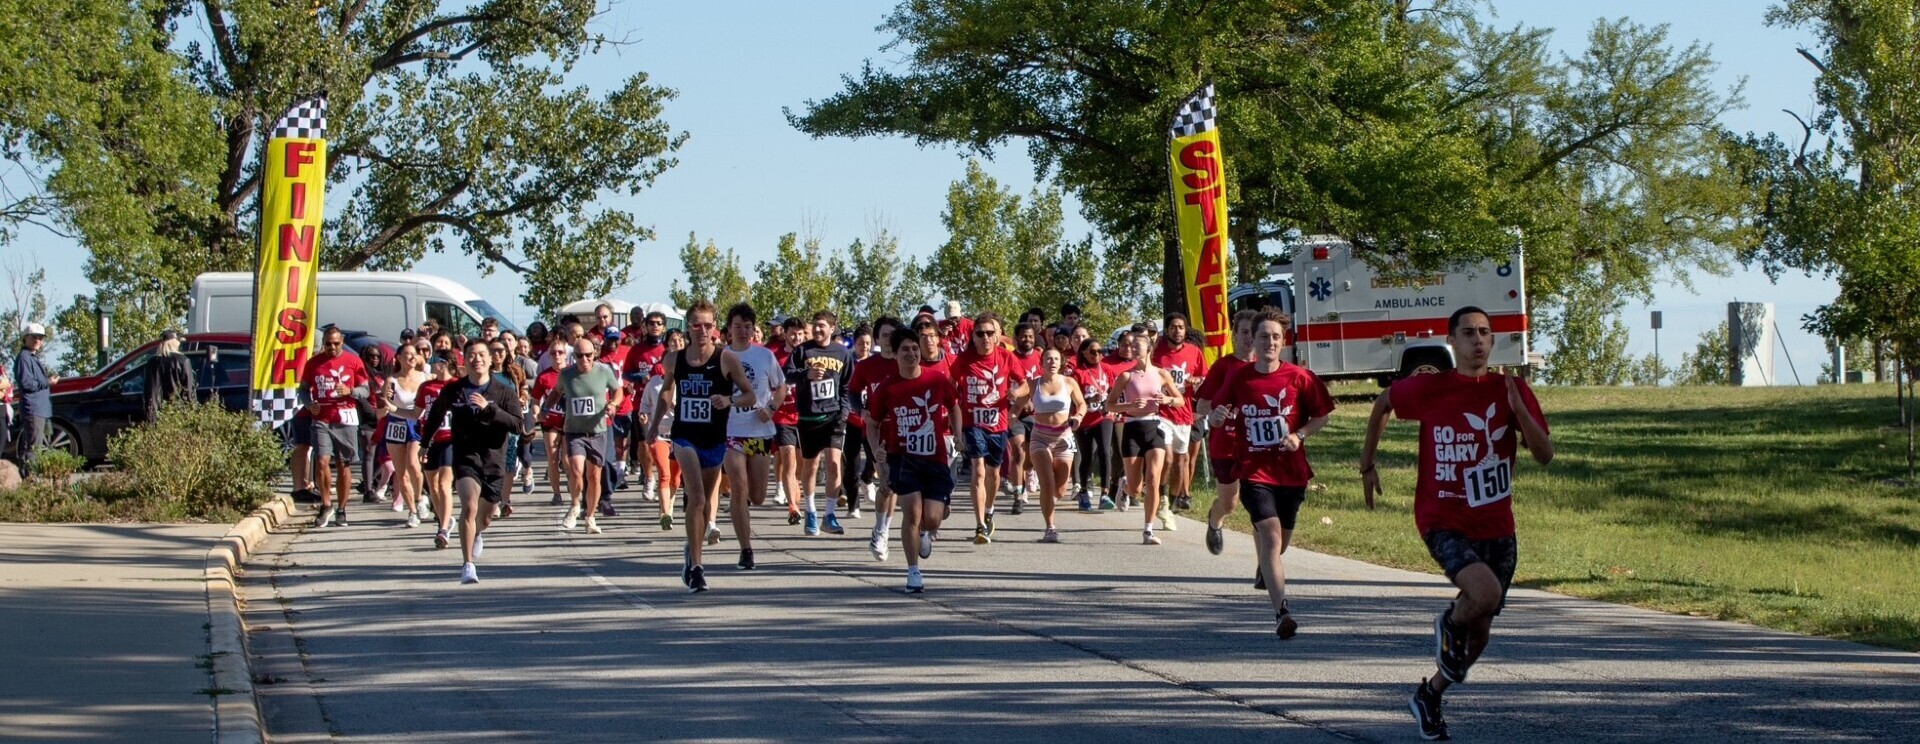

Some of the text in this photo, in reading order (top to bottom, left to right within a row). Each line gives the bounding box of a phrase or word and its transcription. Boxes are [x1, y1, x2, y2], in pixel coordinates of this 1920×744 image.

[271, 142, 316, 385] FINISH
[1374, 297, 1446, 309] AMBULANCE
[680, 380, 713, 396] PIT
[812, 381, 833, 398] 147
[573, 398, 594, 414] 179
[683, 400, 710, 419] 153
[893, 406, 908, 417] GO
[1241, 404, 1257, 416] GO
[896, 415, 922, 427] GARY
[975, 409, 998, 425] 182
[388, 423, 407, 442] 186
[1252, 418, 1283, 442] 181
[1433, 426, 1475, 443] GO FOR
[908, 434, 935, 453] 310
[1435, 443, 1479, 462] GARY
[1435, 463, 1457, 481] 5K
[1468, 462, 1510, 502] 150
